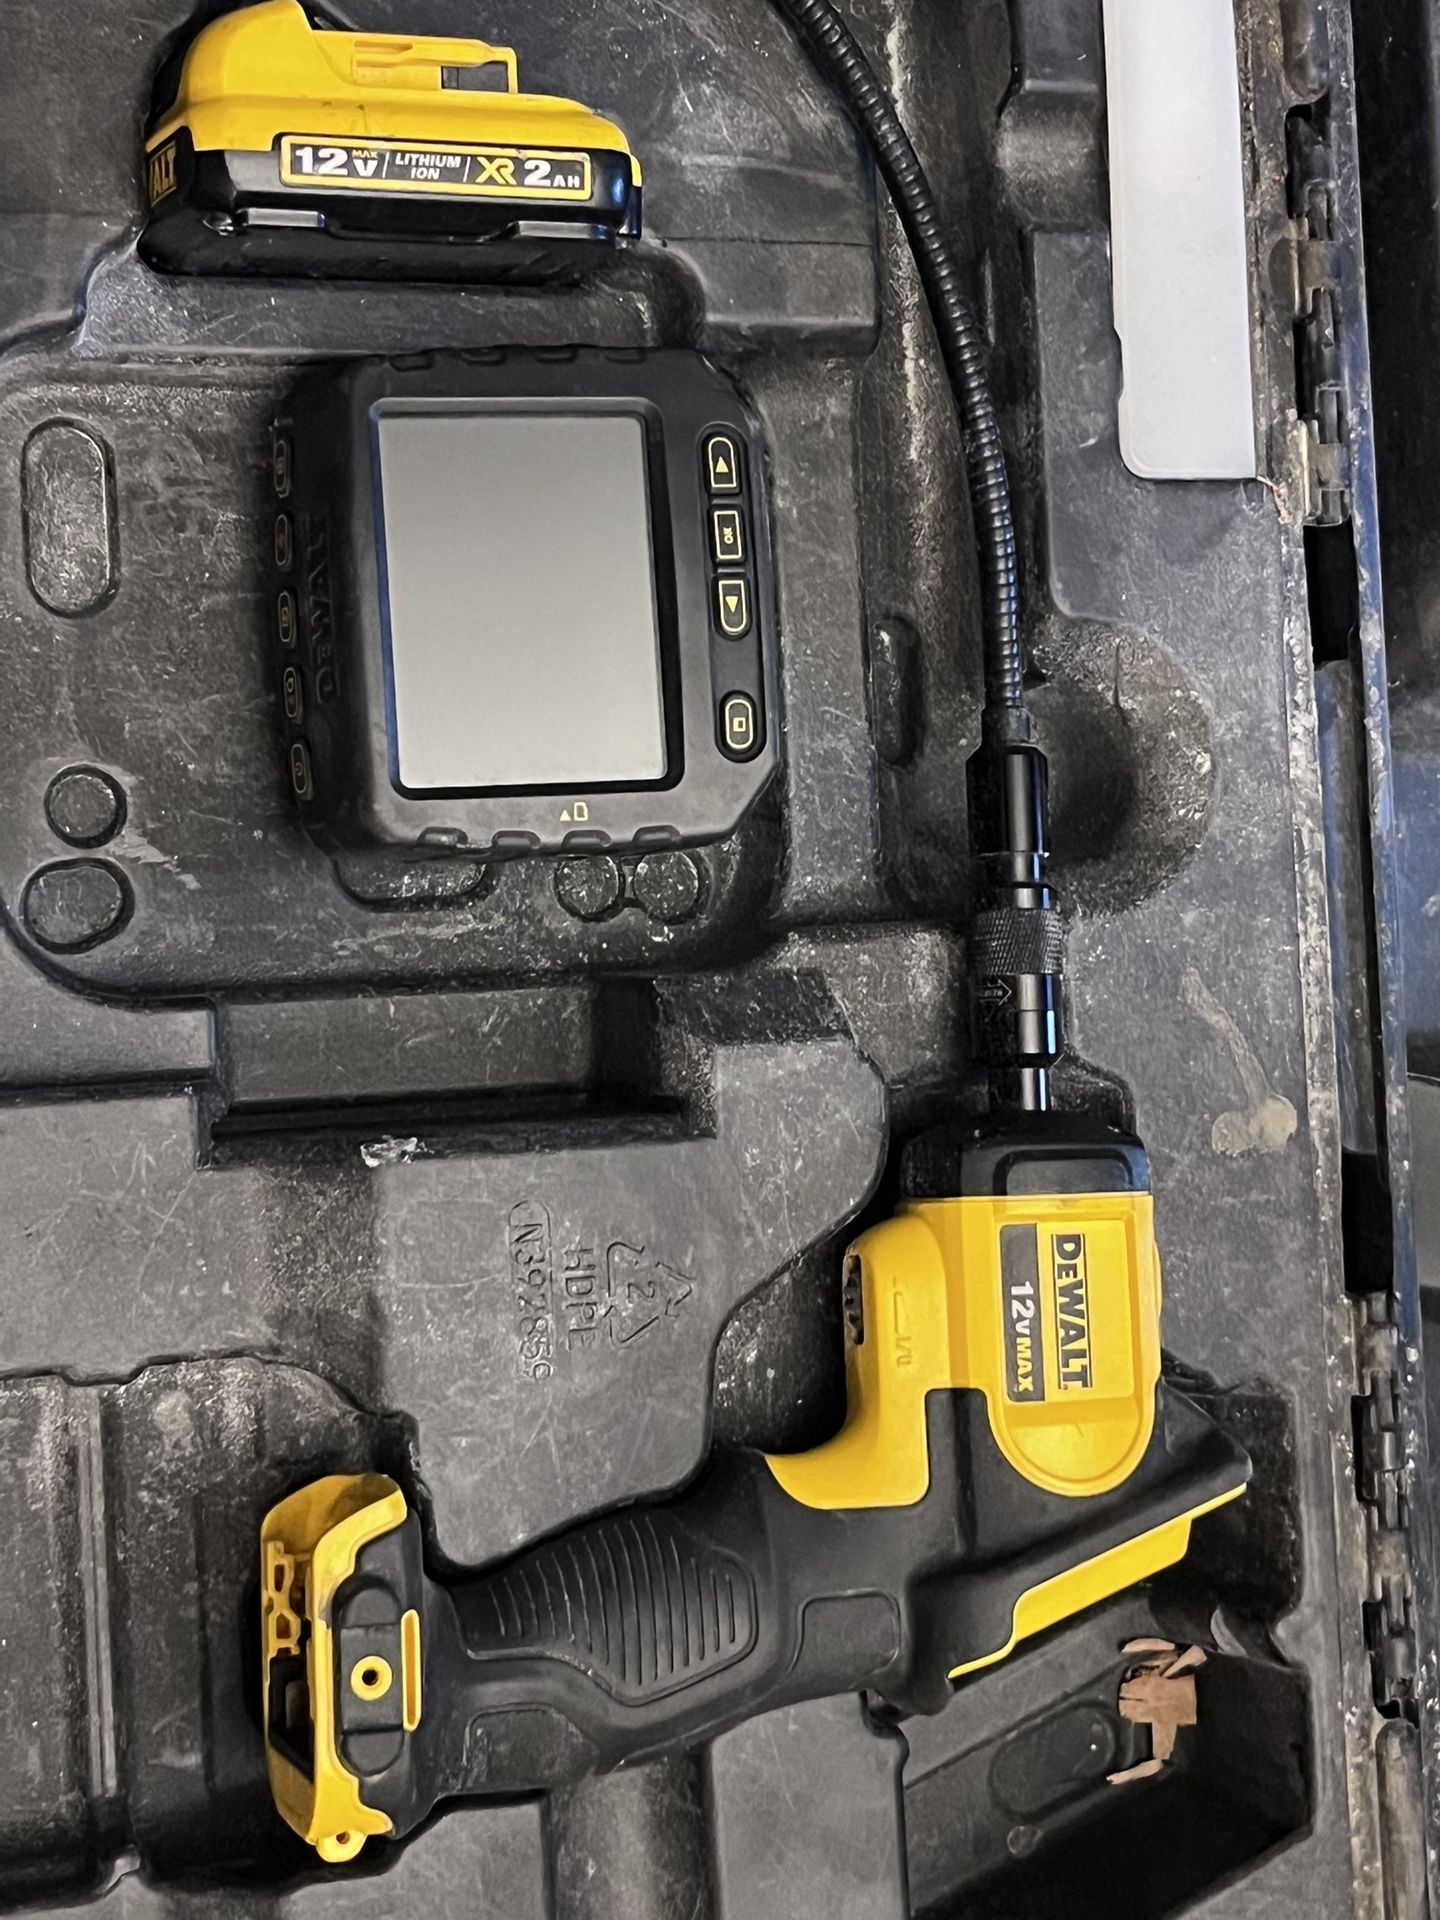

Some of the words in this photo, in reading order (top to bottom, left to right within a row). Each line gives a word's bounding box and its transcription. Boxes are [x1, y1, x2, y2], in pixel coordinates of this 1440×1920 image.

[352, 149, 378, 158] MAX
[395, 153, 461, 168] LITHIUM
[410, 167, 440, 180] ION
[475, 156, 518, 185] XR
[721, 527, 735, 545] OK
[307, 525, 336, 704] DEWAL
[563, 1248, 599, 1350] HDPE
[627, 1280, 656, 1299] 2
[1055, 1234, 1088, 1389] DEWALT
